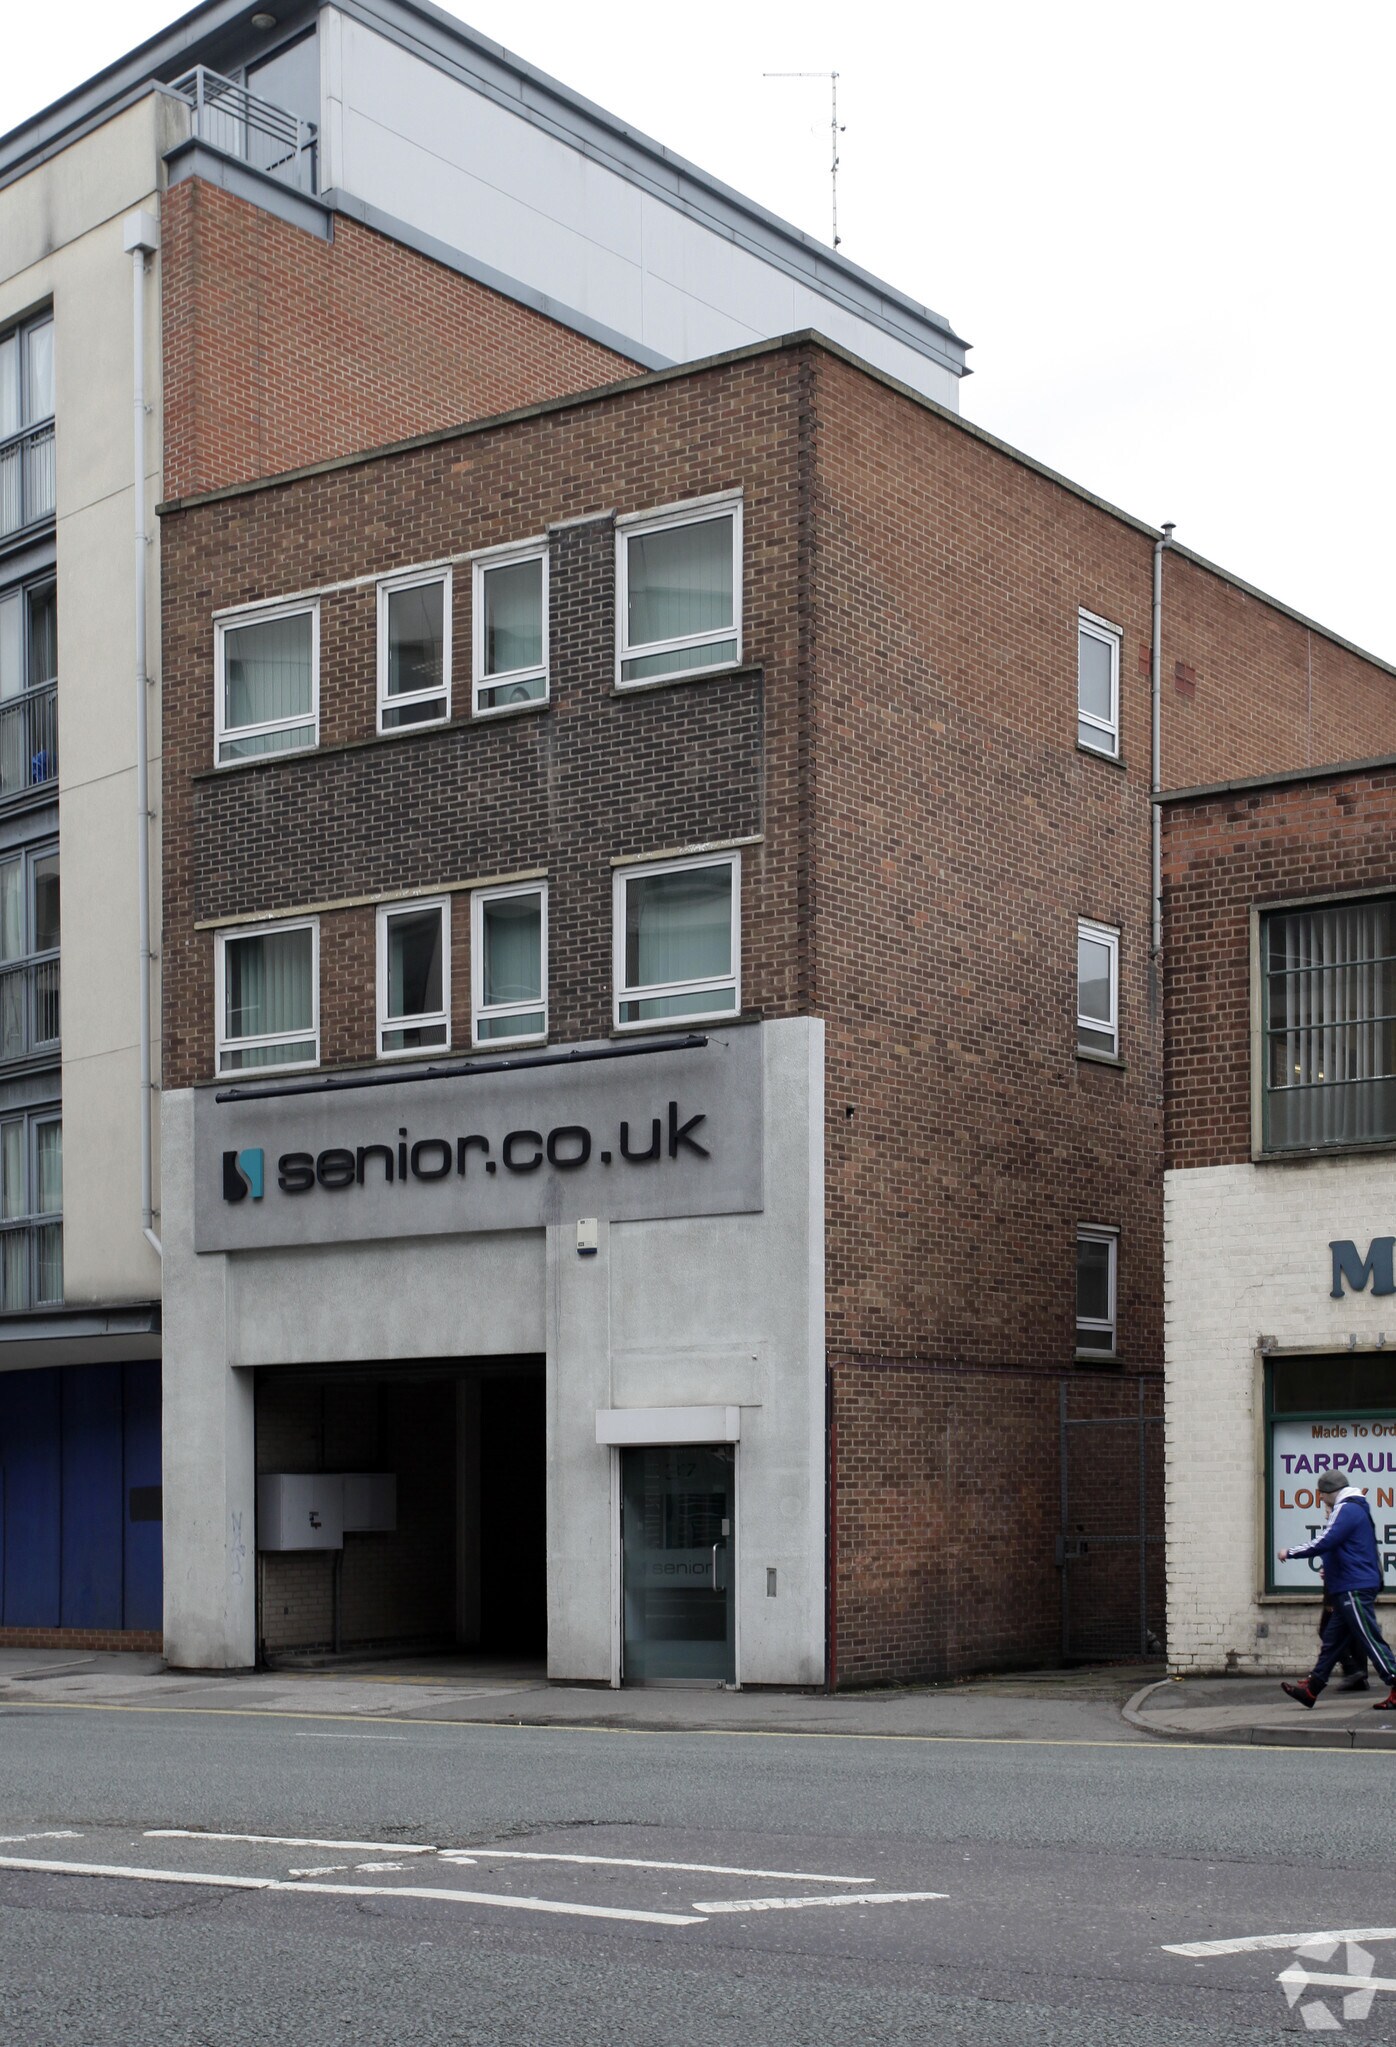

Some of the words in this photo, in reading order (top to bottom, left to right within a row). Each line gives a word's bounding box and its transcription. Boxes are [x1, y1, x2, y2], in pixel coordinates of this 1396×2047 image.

[277, 1101, 711, 1193] senior.co.uk
[1311, 1425, 1347, 1438] Made
[1351, 1424, 1368, 1437] To
